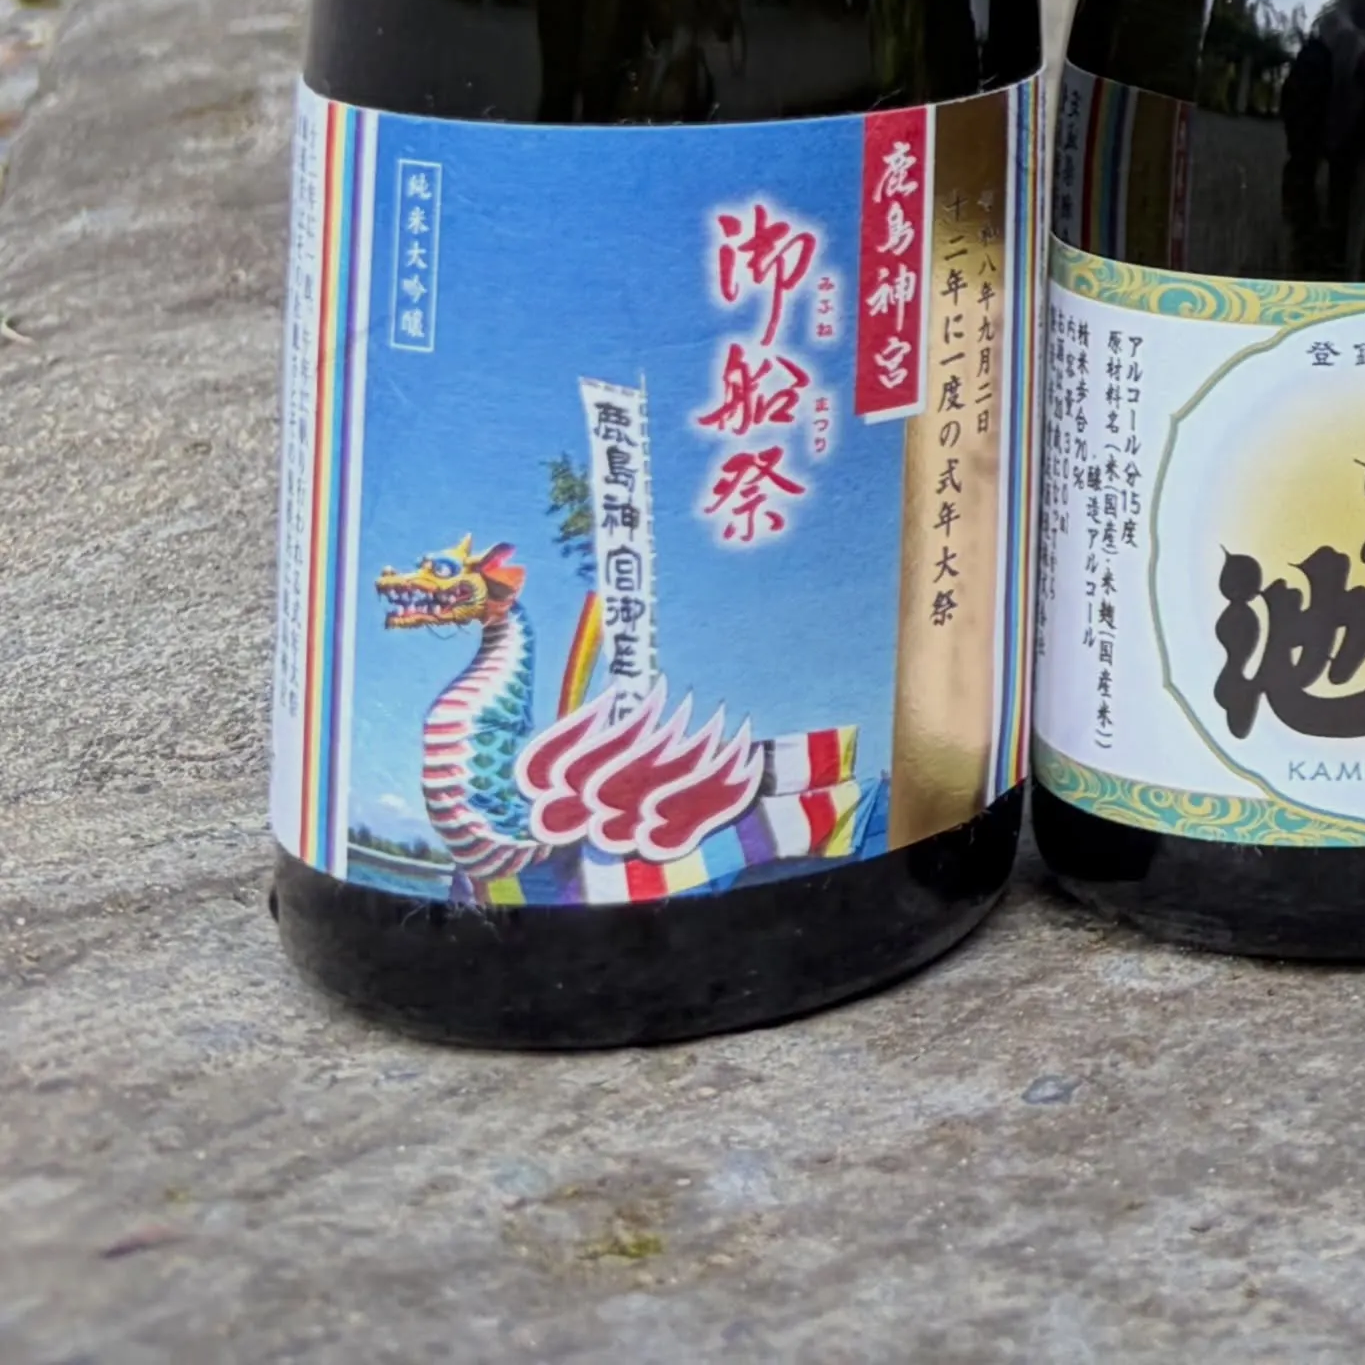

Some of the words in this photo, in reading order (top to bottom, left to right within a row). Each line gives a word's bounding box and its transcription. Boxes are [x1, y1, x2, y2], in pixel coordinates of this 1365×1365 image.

[401, 172, 432, 339] 純米大吟醸
[816, 275, 835, 339] みふね
[867, 141, 919, 389] 鹿島神宮
[697, 204, 818, 543] 御船祭
[813, 395, 830, 454] まつり
[930, 190, 968, 627] 十二年に一度の式年大祭
[1121, 335, 1144, 549] アルコール分15度
